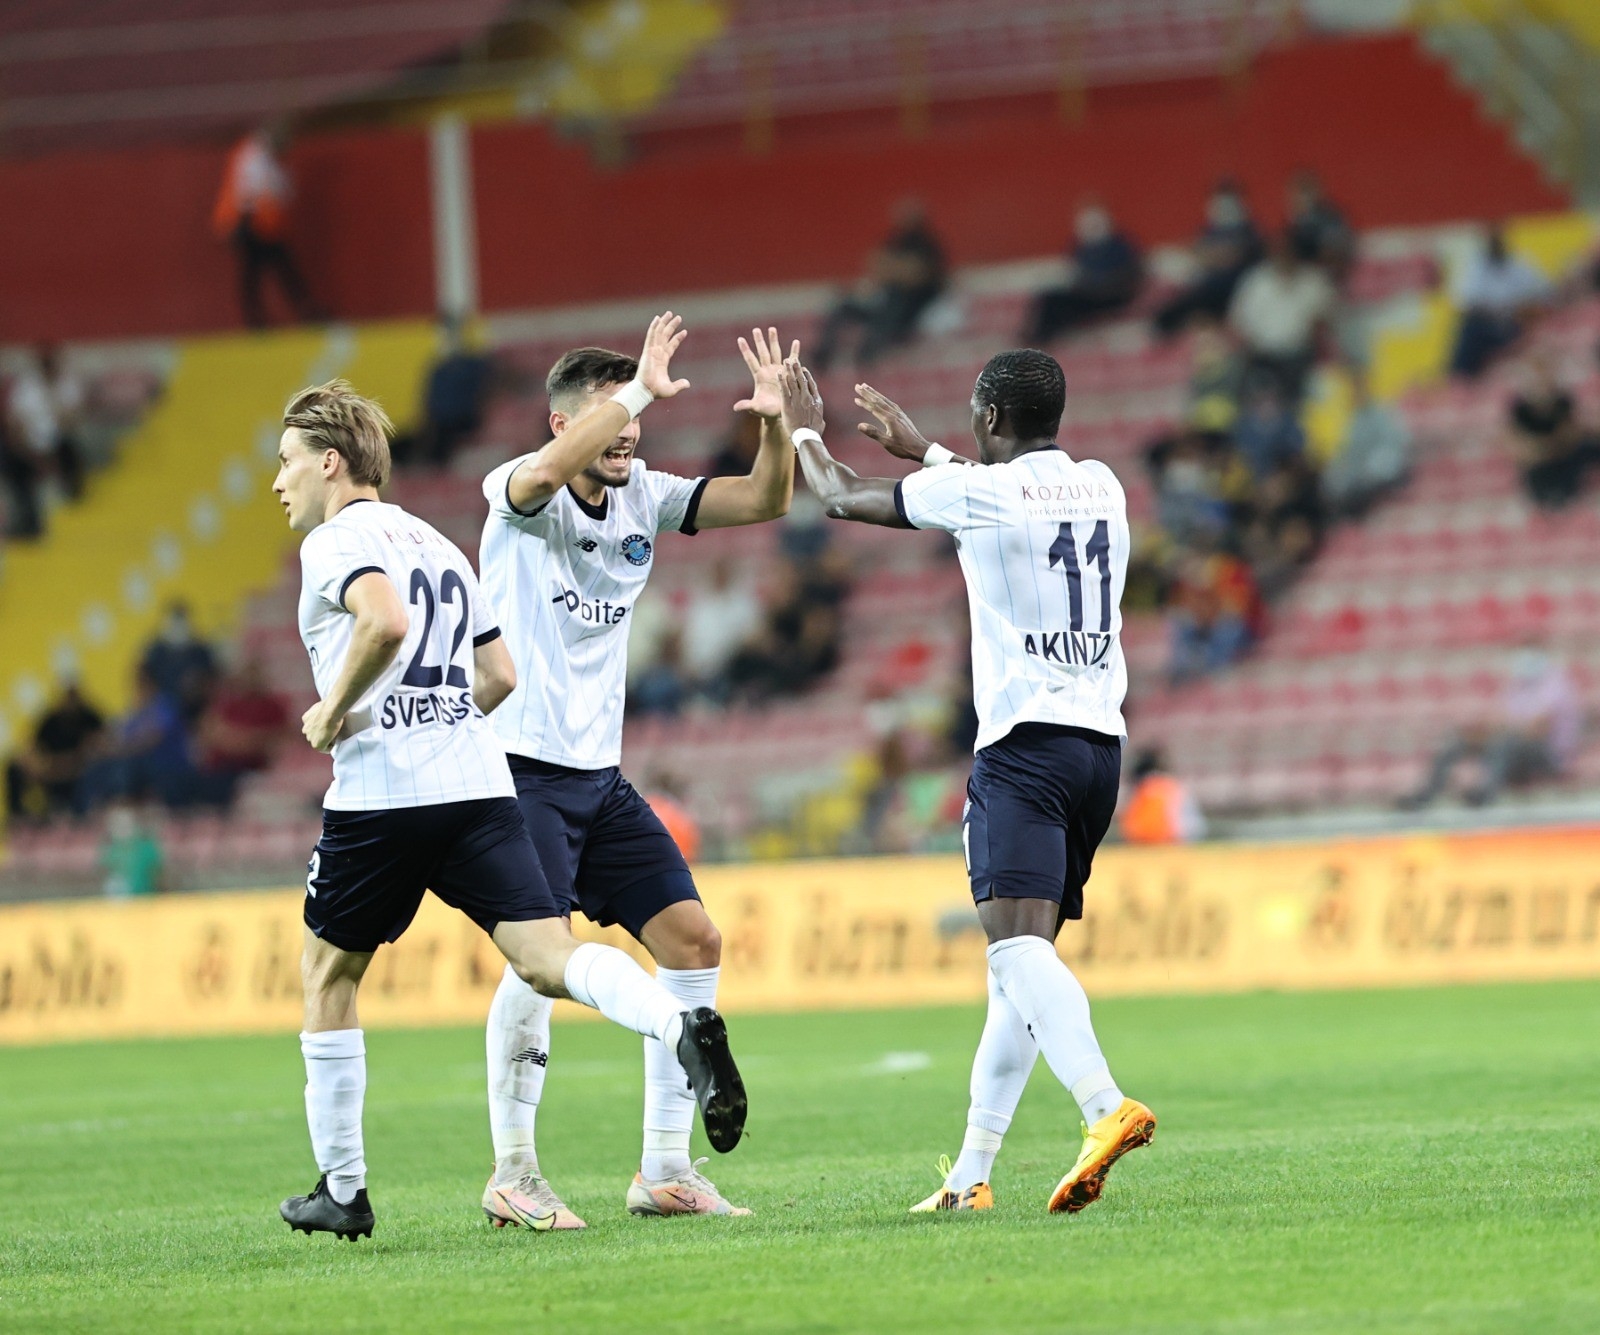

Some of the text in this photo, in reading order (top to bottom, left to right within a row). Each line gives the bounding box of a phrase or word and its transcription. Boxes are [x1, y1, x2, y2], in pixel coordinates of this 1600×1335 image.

[1021, 482, 1109, 501] KOZUVA
[400, 567, 470, 689] 22
[1048, 519, 1112, 633] 11
